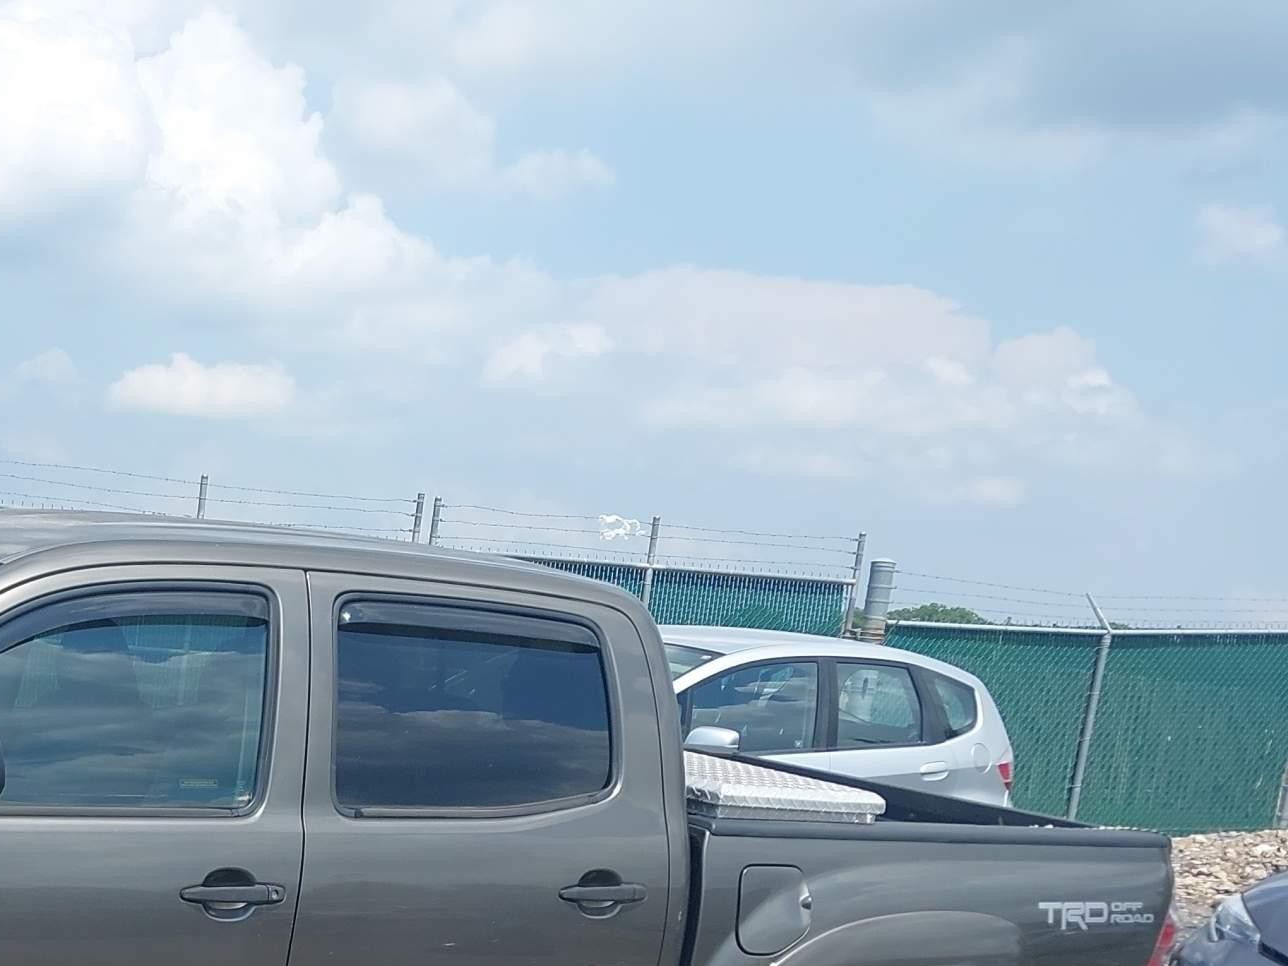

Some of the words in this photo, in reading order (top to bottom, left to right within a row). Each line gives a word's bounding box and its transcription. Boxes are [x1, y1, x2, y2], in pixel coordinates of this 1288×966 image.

[1111, 902, 1144, 912] OFF
[1037, 901, 1109, 931] TRD
[1110, 913, 1155, 924] ROAD
